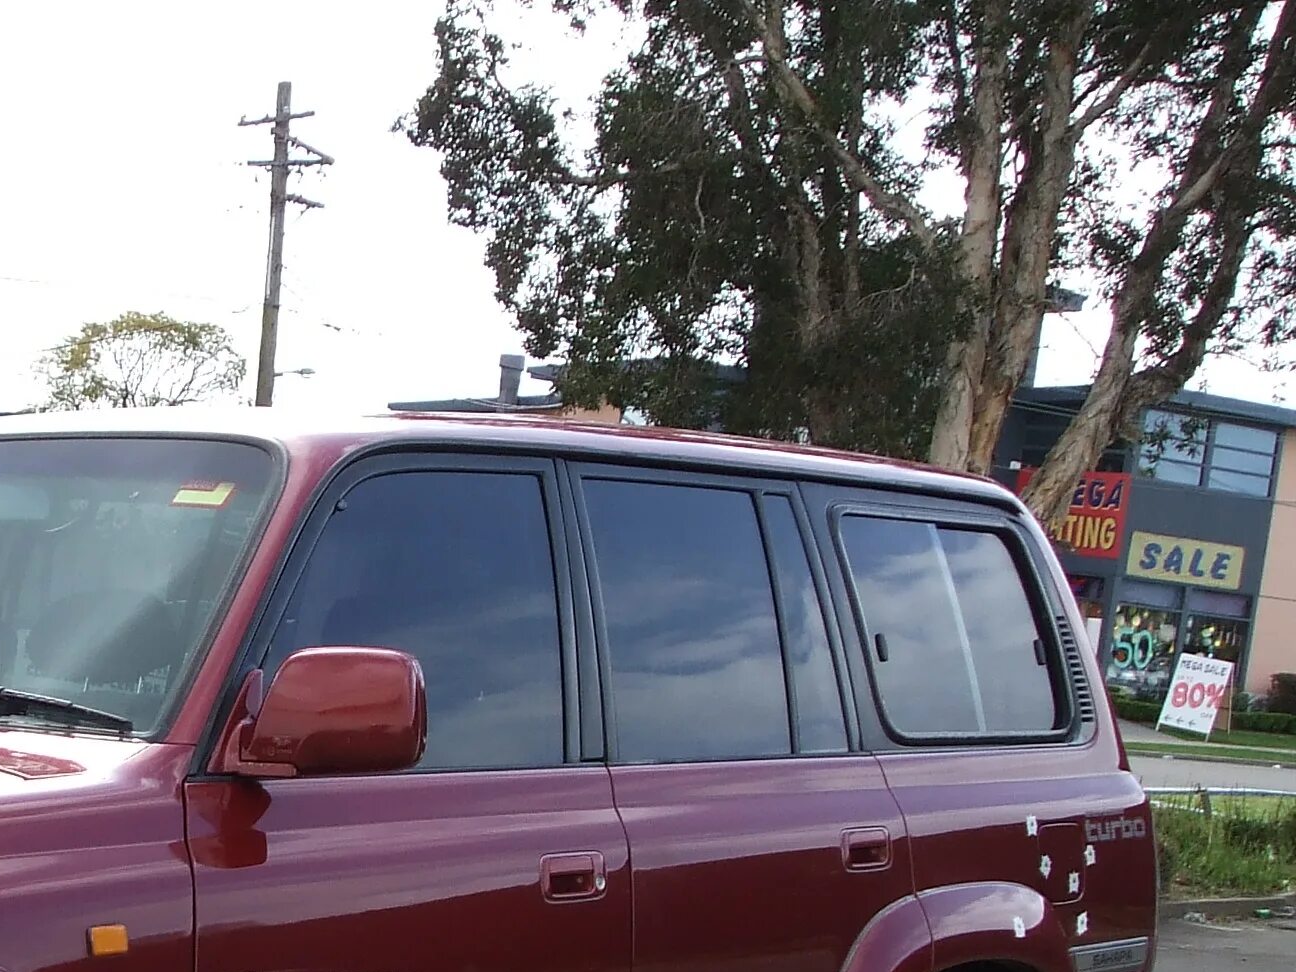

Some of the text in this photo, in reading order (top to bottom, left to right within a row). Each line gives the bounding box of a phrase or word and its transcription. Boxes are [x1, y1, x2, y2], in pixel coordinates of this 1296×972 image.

[1071, 479, 1124, 511] EGA
[1139, 542, 1231, 580] SALE
[1113, 626, 1154, 670] 50
[1204, 663, 1228, 677] SALE
[1171, 681, 1225, 709] 80%
[1085, 817, 1146, 842] turbo
